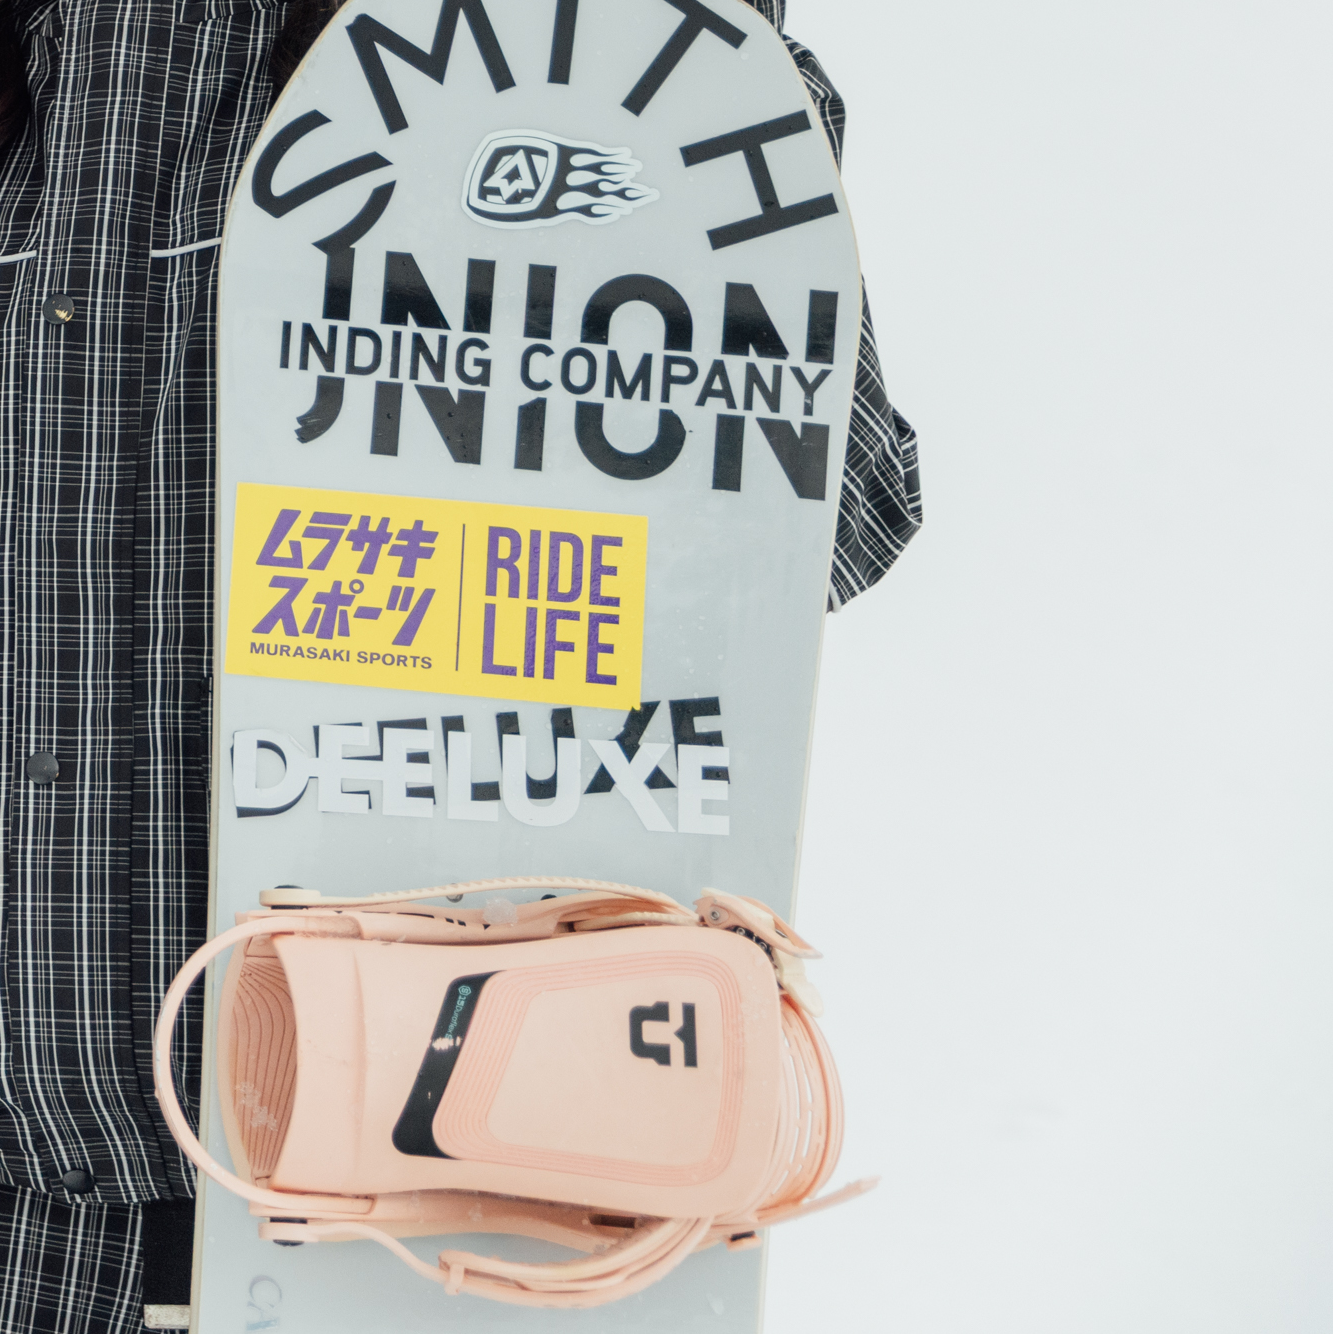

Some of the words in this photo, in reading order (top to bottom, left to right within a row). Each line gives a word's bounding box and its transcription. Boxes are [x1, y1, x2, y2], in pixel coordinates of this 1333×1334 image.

[519, 342, 833, 417] COMPANY
[255, 508, 440, 579] ムラサキ
[484, 525, 624, 607] RIDE
[251, 575, 437, 647] スポーツ
[480, 602, 622, 686] LIFE
[249, 641, 351, 663] MURASAKI
[356, 650, 433, 670] SPORTS
[231, 723, 731, 837] DEELUXE
